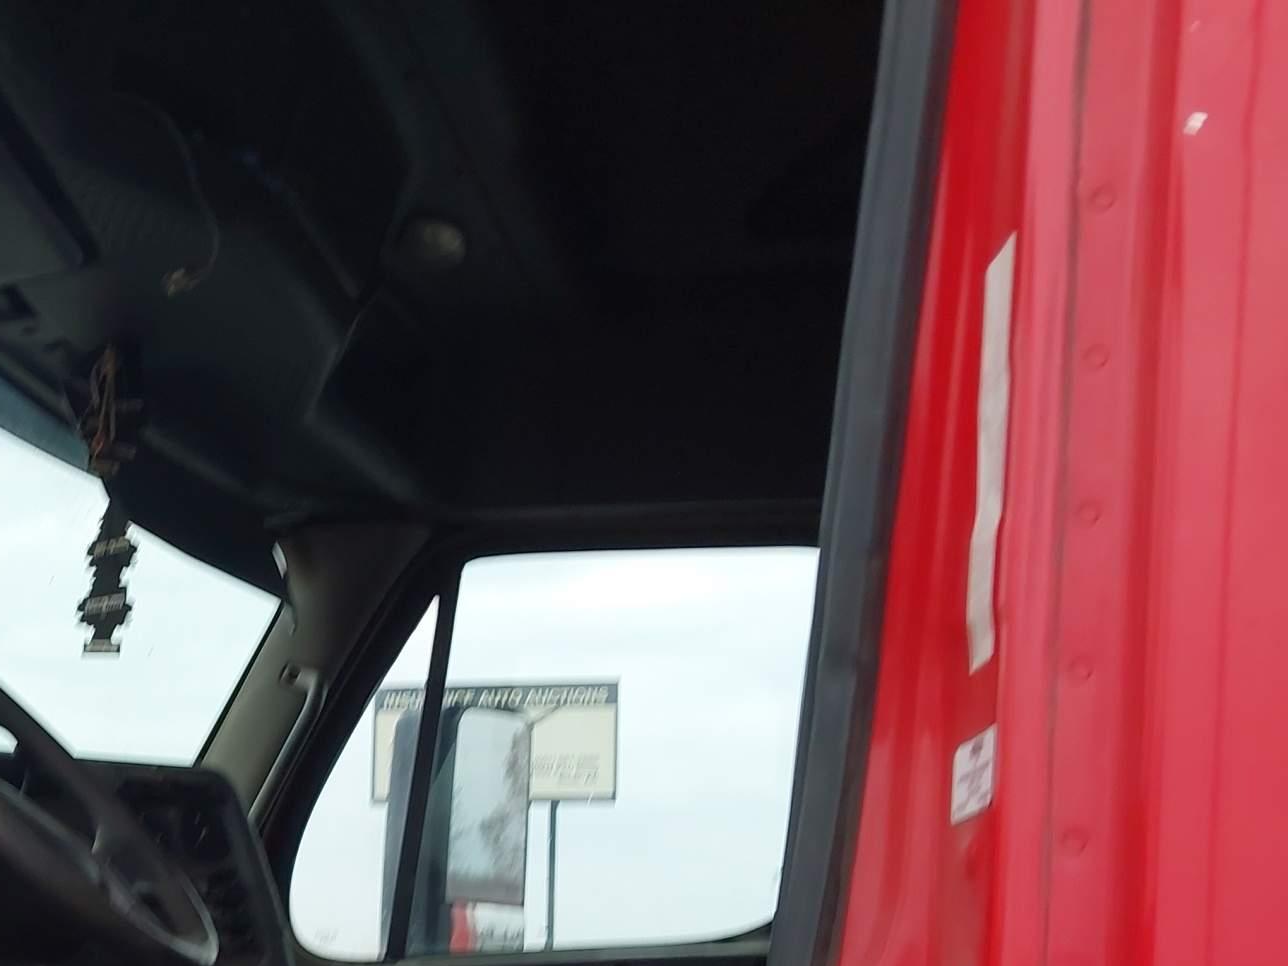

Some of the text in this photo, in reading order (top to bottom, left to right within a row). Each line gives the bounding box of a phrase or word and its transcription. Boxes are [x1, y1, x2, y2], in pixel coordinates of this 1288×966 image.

[383, 686, 609, 710] INSUNCE AUTO AUCTIONS
